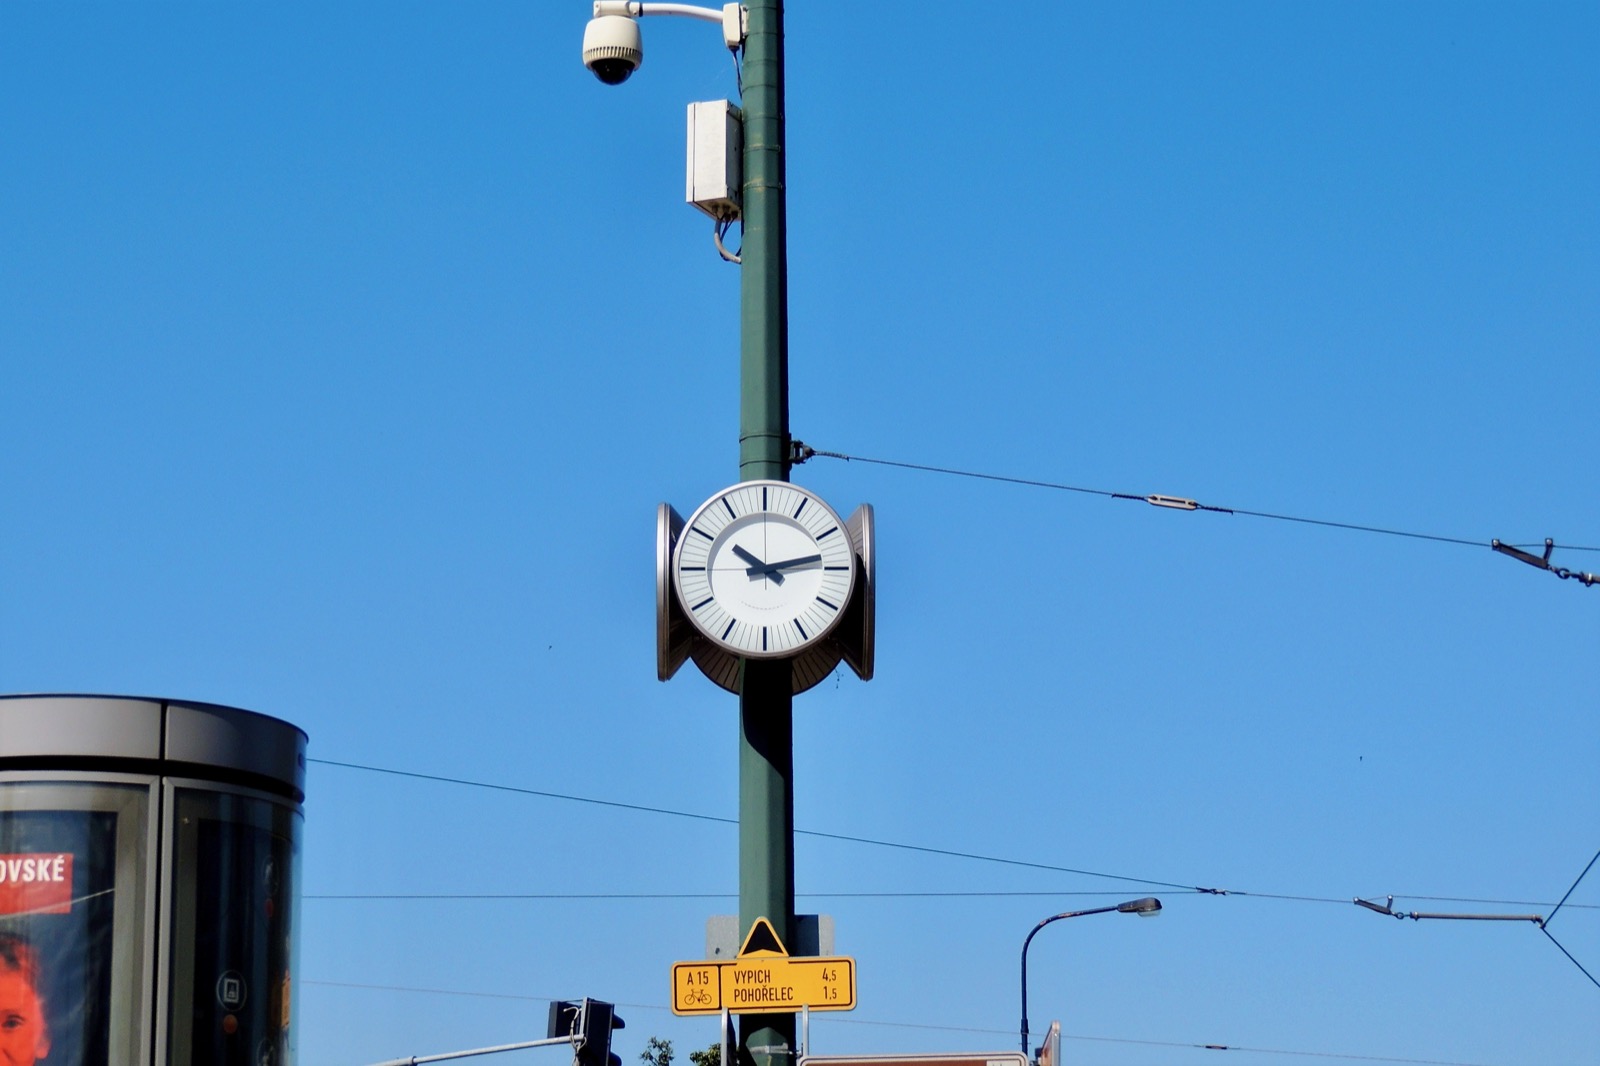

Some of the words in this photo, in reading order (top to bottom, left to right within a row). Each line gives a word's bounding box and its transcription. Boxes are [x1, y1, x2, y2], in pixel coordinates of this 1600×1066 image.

[687, 971, 694, 985] A
[697, 970, 709, 985] 15
[734, 969, 771, 984] VYPICH
[822, 967, 837, 983] 4,5
[734, 984, 794, 1003] POHOŘELEC
[823, 985, 837, 1001] 1,5
